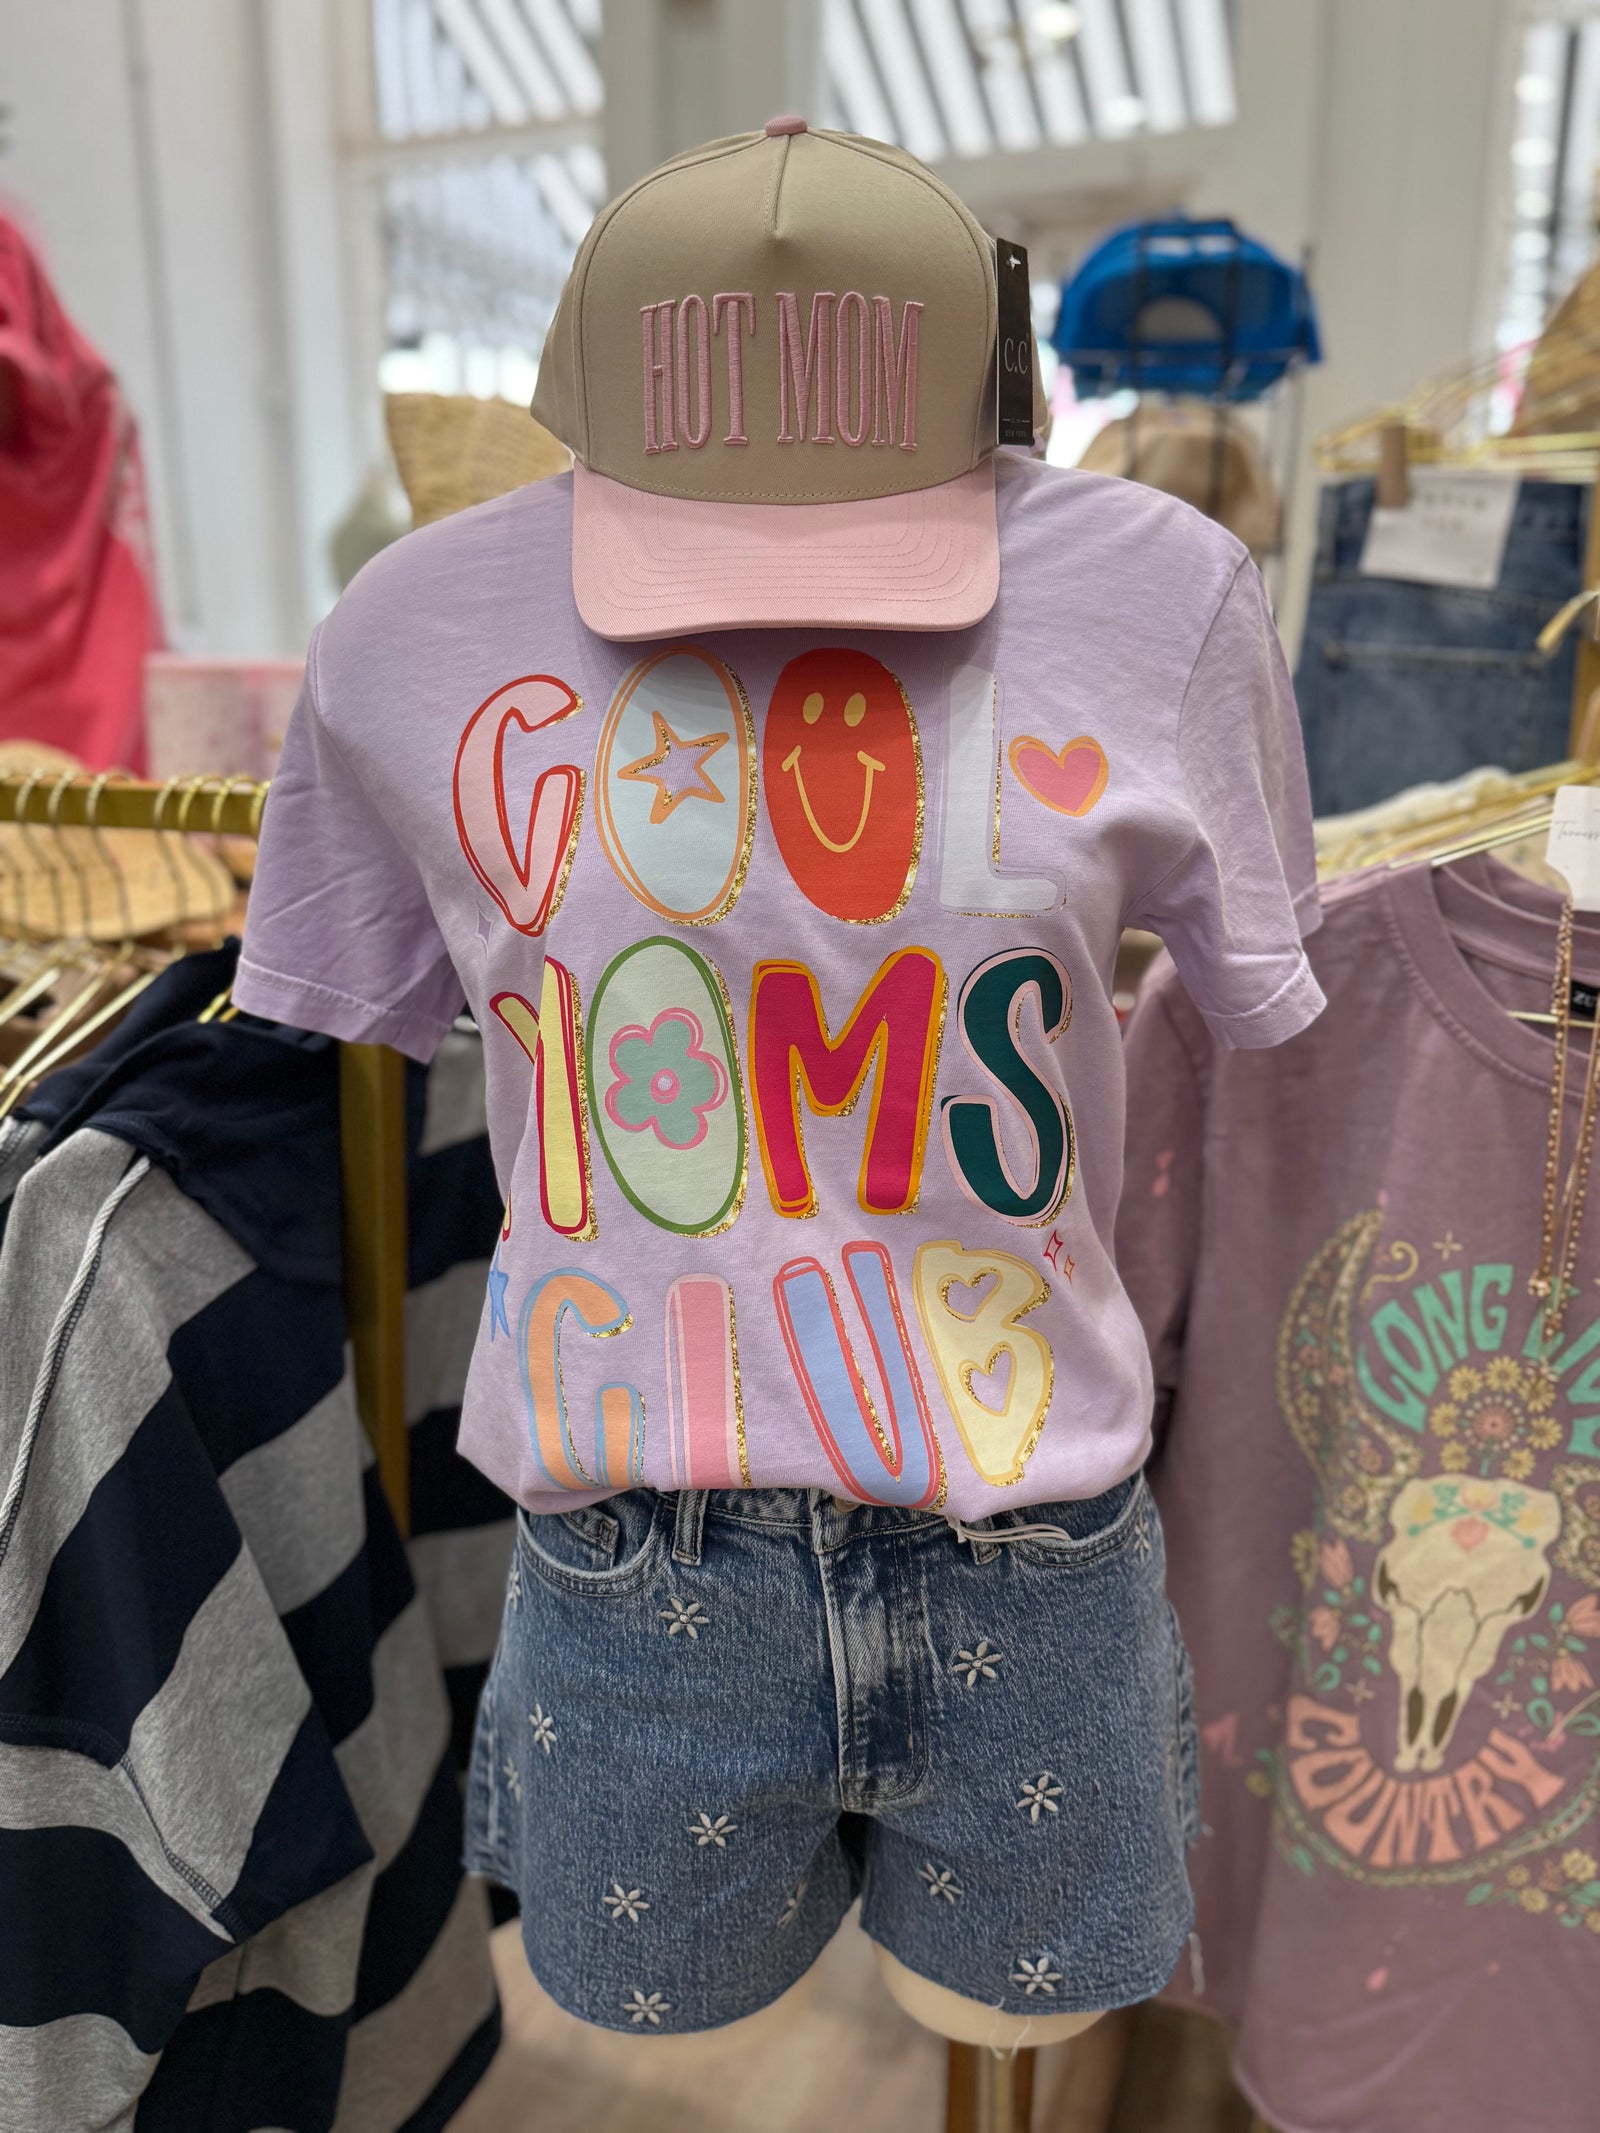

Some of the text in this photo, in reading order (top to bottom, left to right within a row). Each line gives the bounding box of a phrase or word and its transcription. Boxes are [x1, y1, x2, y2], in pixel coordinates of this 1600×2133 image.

[639, 291, 924, 455] HOT MOM
[453, 645, 1068, 938] COOL
[1357, 1263, 1514, 1434] LONG
[1287, 1694, 1566, 1868] COUNTRY
